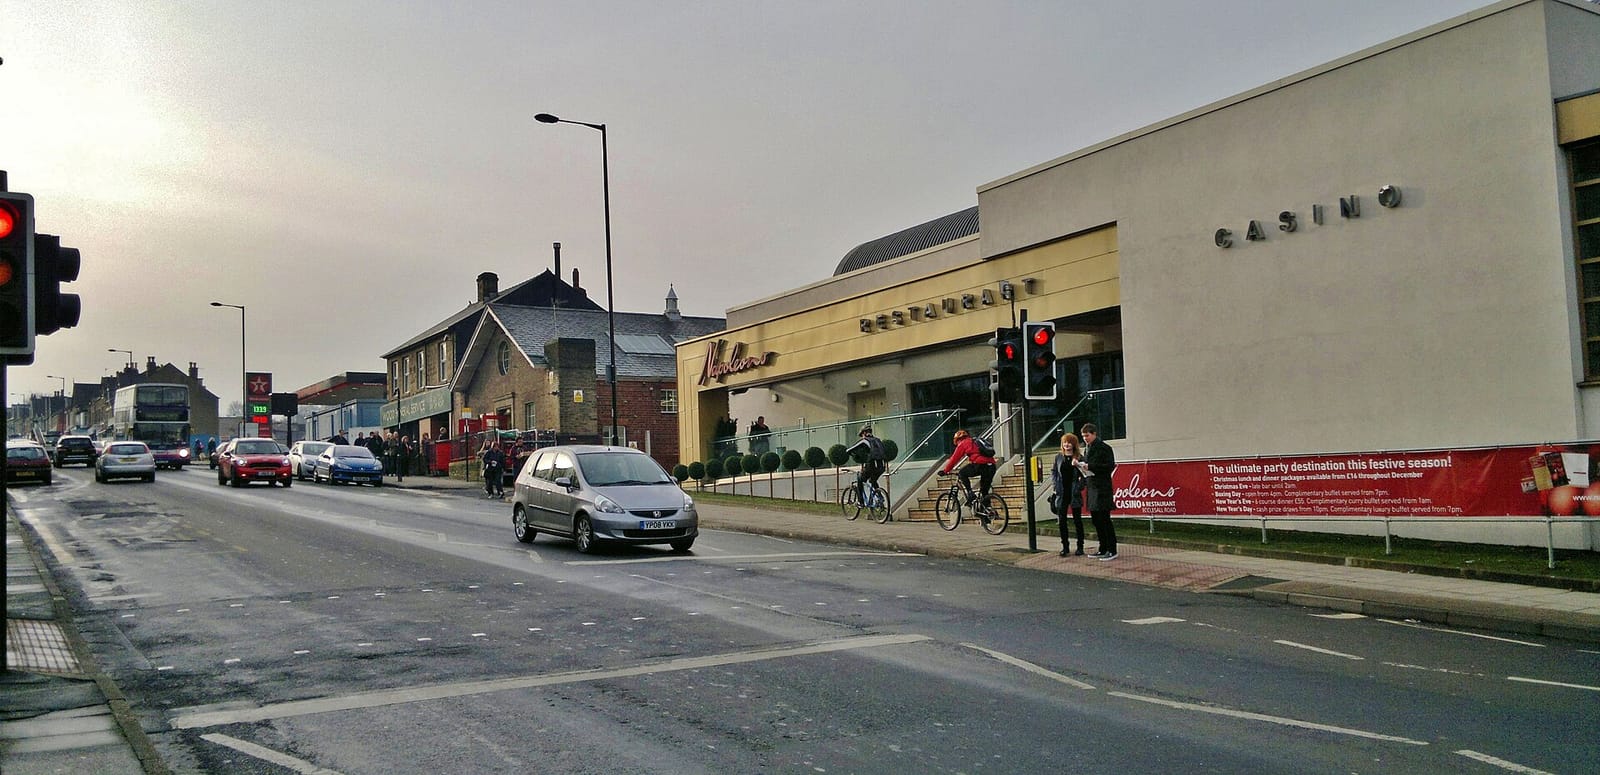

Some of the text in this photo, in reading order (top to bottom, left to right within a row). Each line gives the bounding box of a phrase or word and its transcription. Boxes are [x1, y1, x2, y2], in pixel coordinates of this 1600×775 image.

[1214, 184, 1401, 248] CASINO
[698, 339, 778, 385] Napoleons
[1208, 456, 1452, 474] The ultimate party destination this festive season!
[1280, 474, 1306, 482] packages
[1358, 472, 1390, 480] throughout
[1391, 471, 1423, 479] December
[1111, 464, 1180, 502] poleons
[1231, 490, 1241, 498] Day
[1115, 500, 1142, 509] CASINO
[1306, 497, 1347, 505] Complimentary
[1330, 505, 1372, 513] Complimentary
[1373, 505, 1391, 513] luxury
[1391, 505, 1410, 513] buffet
[1411, 505, 1431, 513] served
